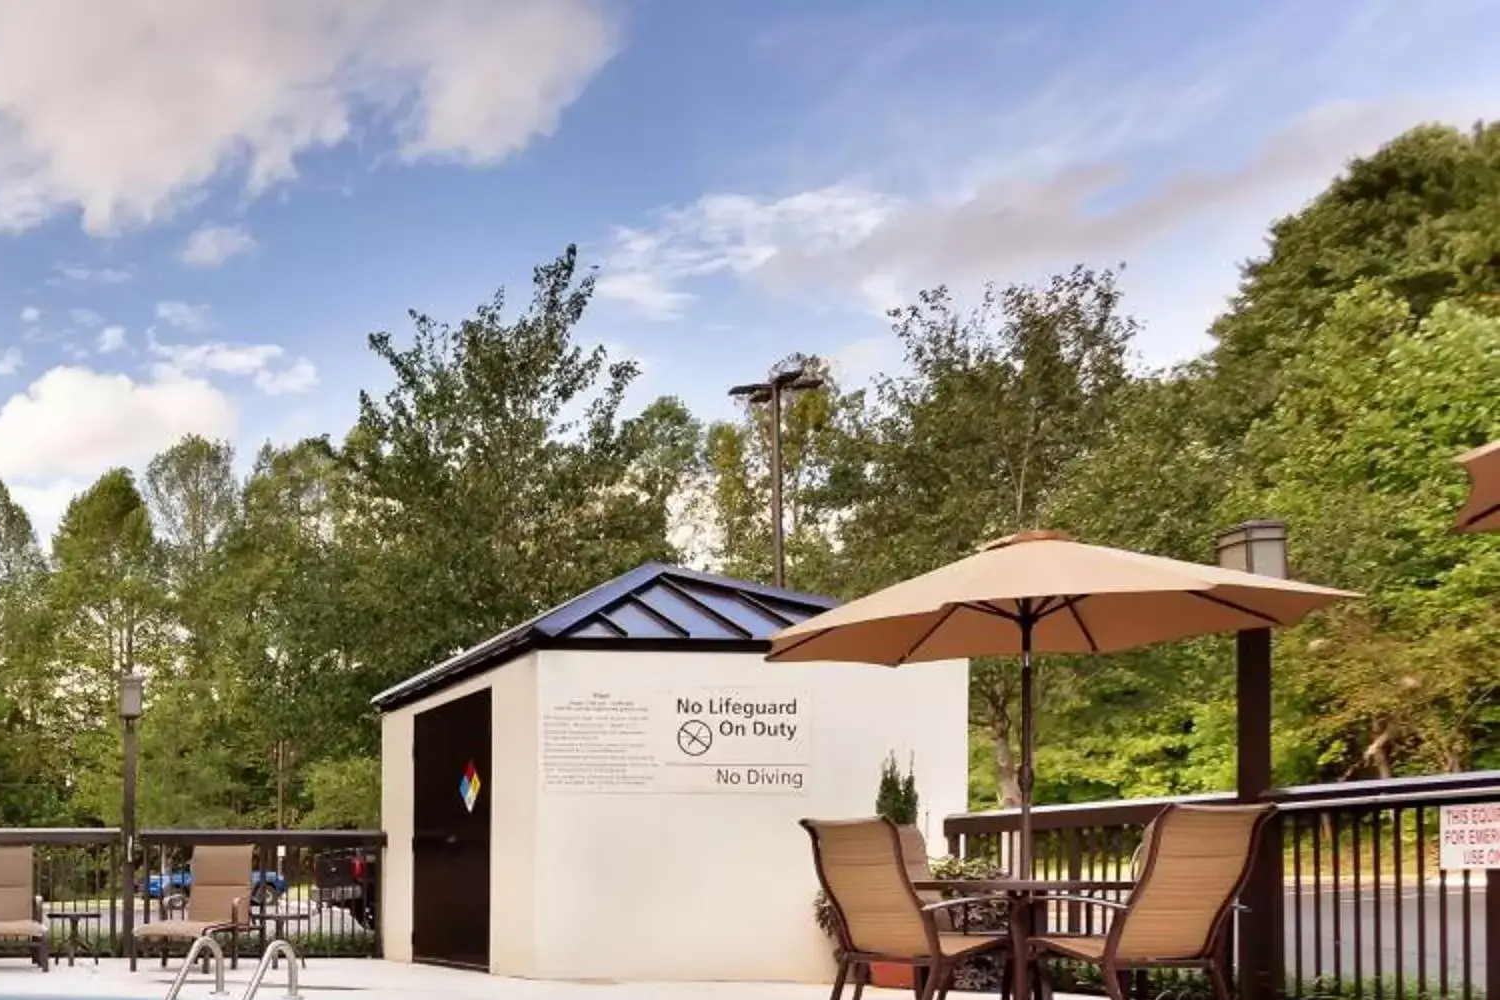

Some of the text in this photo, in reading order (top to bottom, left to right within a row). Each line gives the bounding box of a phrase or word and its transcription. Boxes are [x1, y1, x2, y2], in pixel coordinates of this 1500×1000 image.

[677, 697, 797, 719] No Lifeguard
[719, 720, 797, 741] On Duty
[716, 768, 803, 788] No Diving
[1445, 829, 1466, 845] FOR
[1463, 849, 1484, 865] USE
